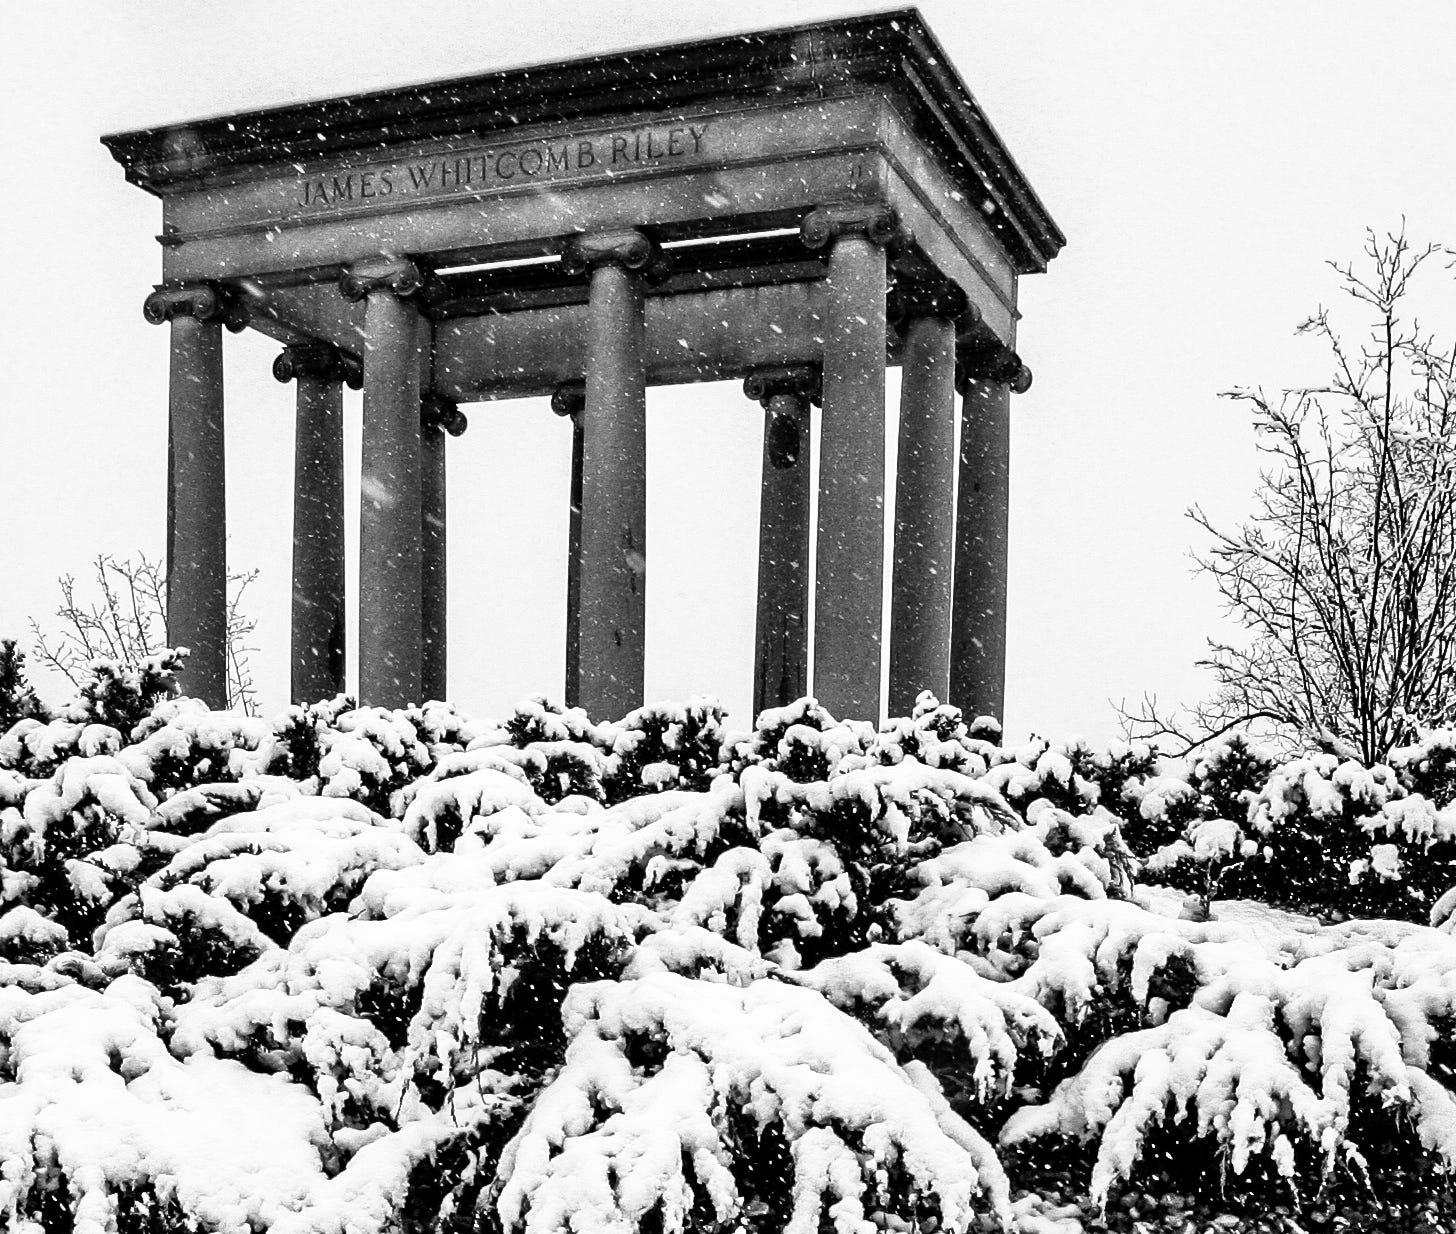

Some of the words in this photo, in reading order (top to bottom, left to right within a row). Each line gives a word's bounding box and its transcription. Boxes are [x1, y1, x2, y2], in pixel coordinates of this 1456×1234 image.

[298, 169, 393, 207] JAMES
[408, 141, 595, 190] WHITCOMB
[611, 124, 708, 164] RILEY
